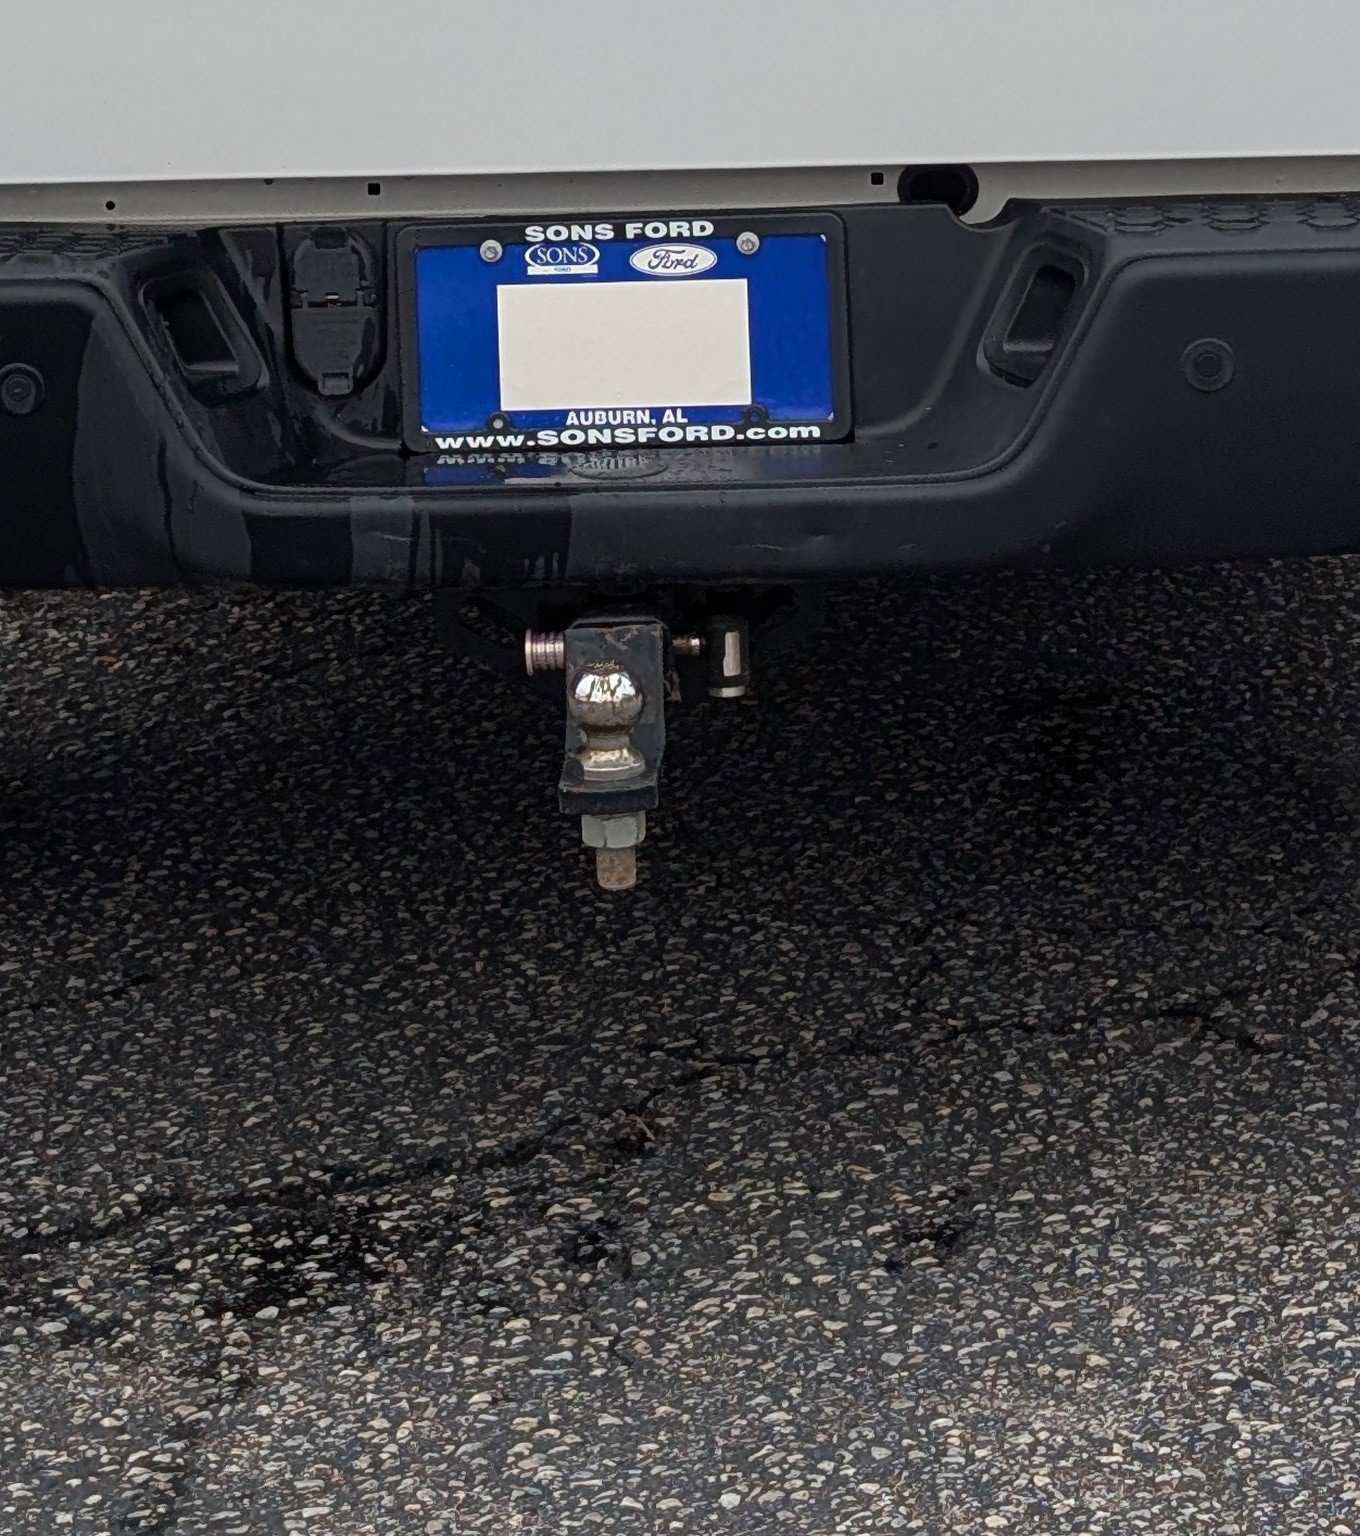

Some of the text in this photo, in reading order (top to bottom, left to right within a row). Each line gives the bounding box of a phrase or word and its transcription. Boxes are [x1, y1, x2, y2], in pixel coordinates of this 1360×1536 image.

[524, 221, 715, 243] SONS FORD
[536, 246, 589, 264] SONS
[648, 248, 700, 270] Ford
[566, 407, 688, 426] AUBURN, AL
[436, 423, 822, 450] www.SONSFORD.com
